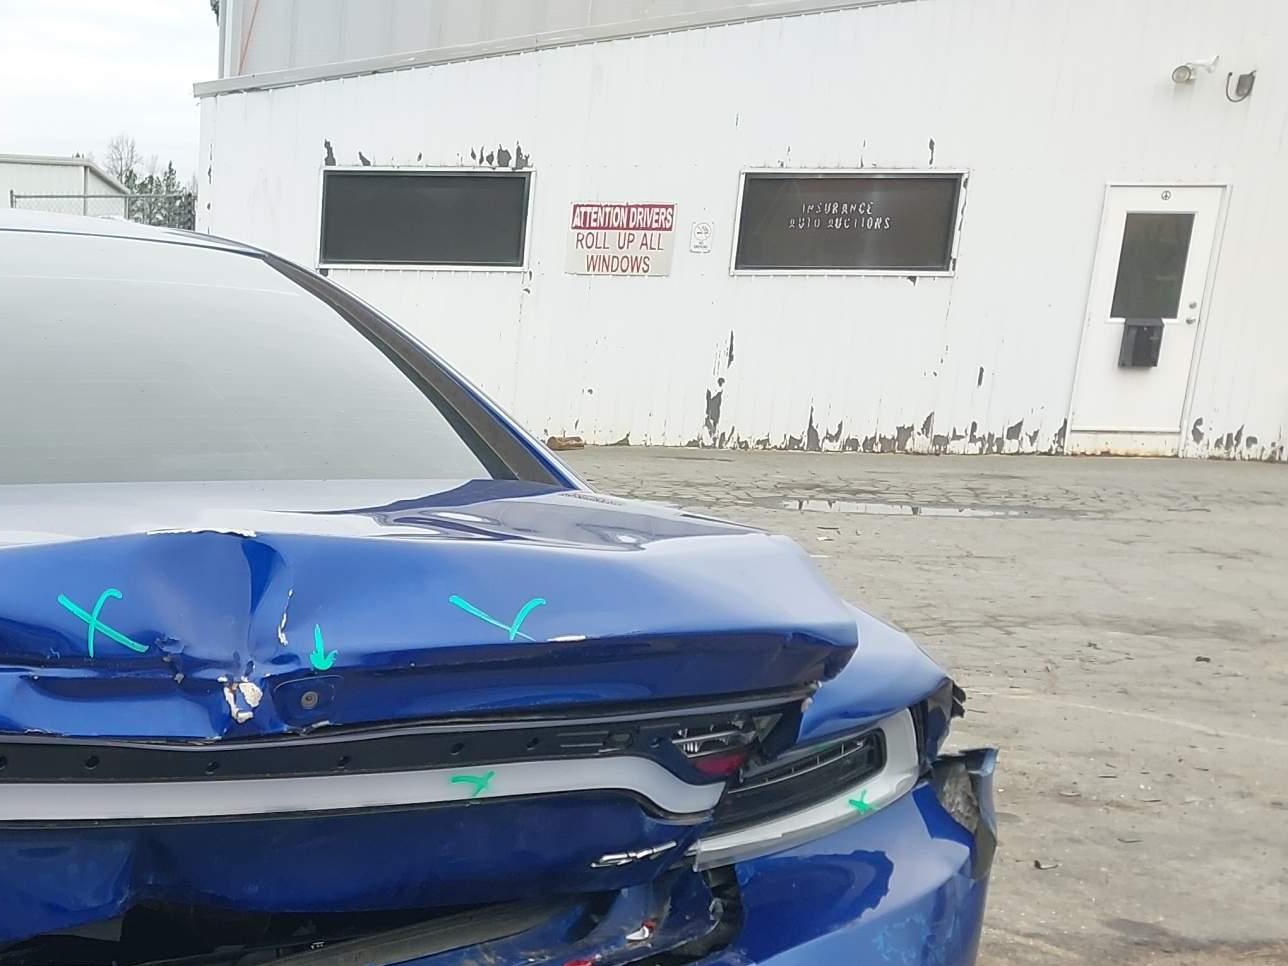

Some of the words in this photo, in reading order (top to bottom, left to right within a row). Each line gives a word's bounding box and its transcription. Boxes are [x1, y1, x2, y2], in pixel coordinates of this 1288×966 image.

[572, 206, 628, 228] ATTENTION
[629, 207, 673, 229] DRIVERS
[576, 232, 610, 249] ROLL
[617, 232, 635, 250] UP
[639, 233, 664, 250] ALL
[586, 254, 650, 273] WINDOWS
